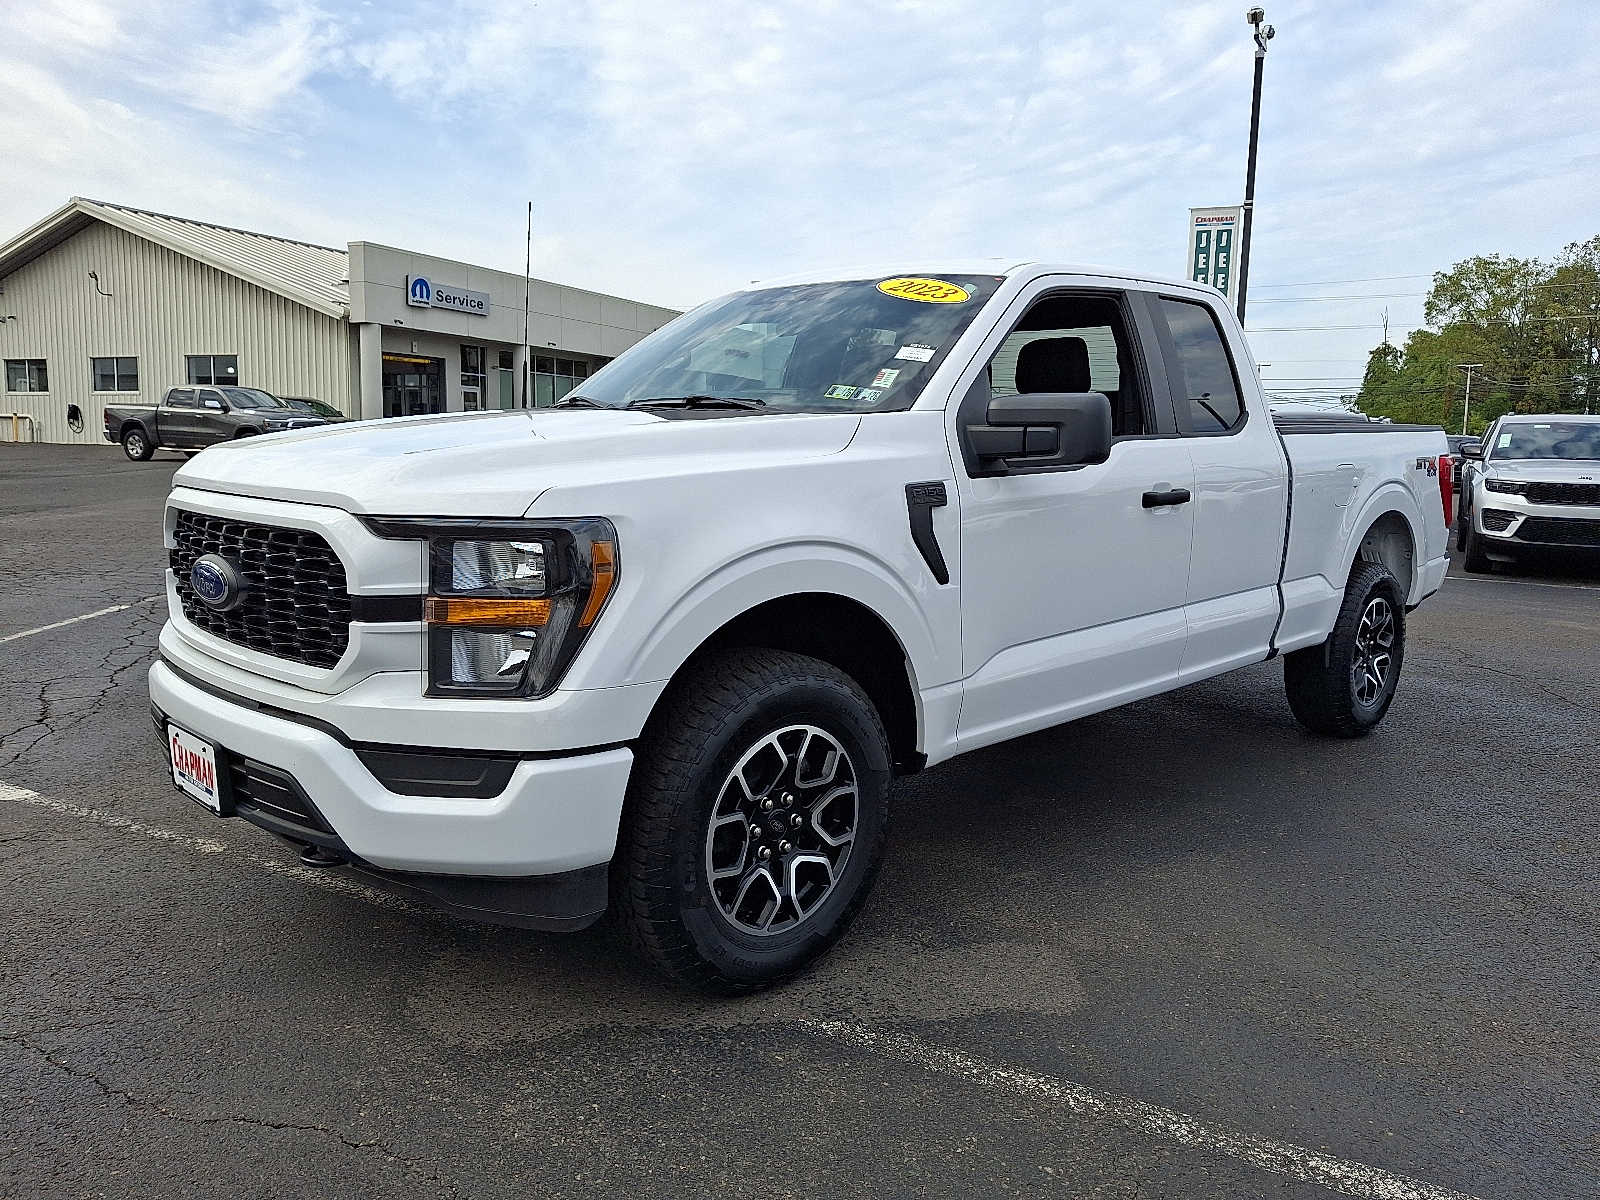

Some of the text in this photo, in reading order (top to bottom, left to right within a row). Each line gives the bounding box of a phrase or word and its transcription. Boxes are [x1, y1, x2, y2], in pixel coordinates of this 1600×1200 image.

[435, 289, 484, 310] Service
[886, 281, 958, 299] 2023
[172, 736, 214, 790] CHAPMAN
